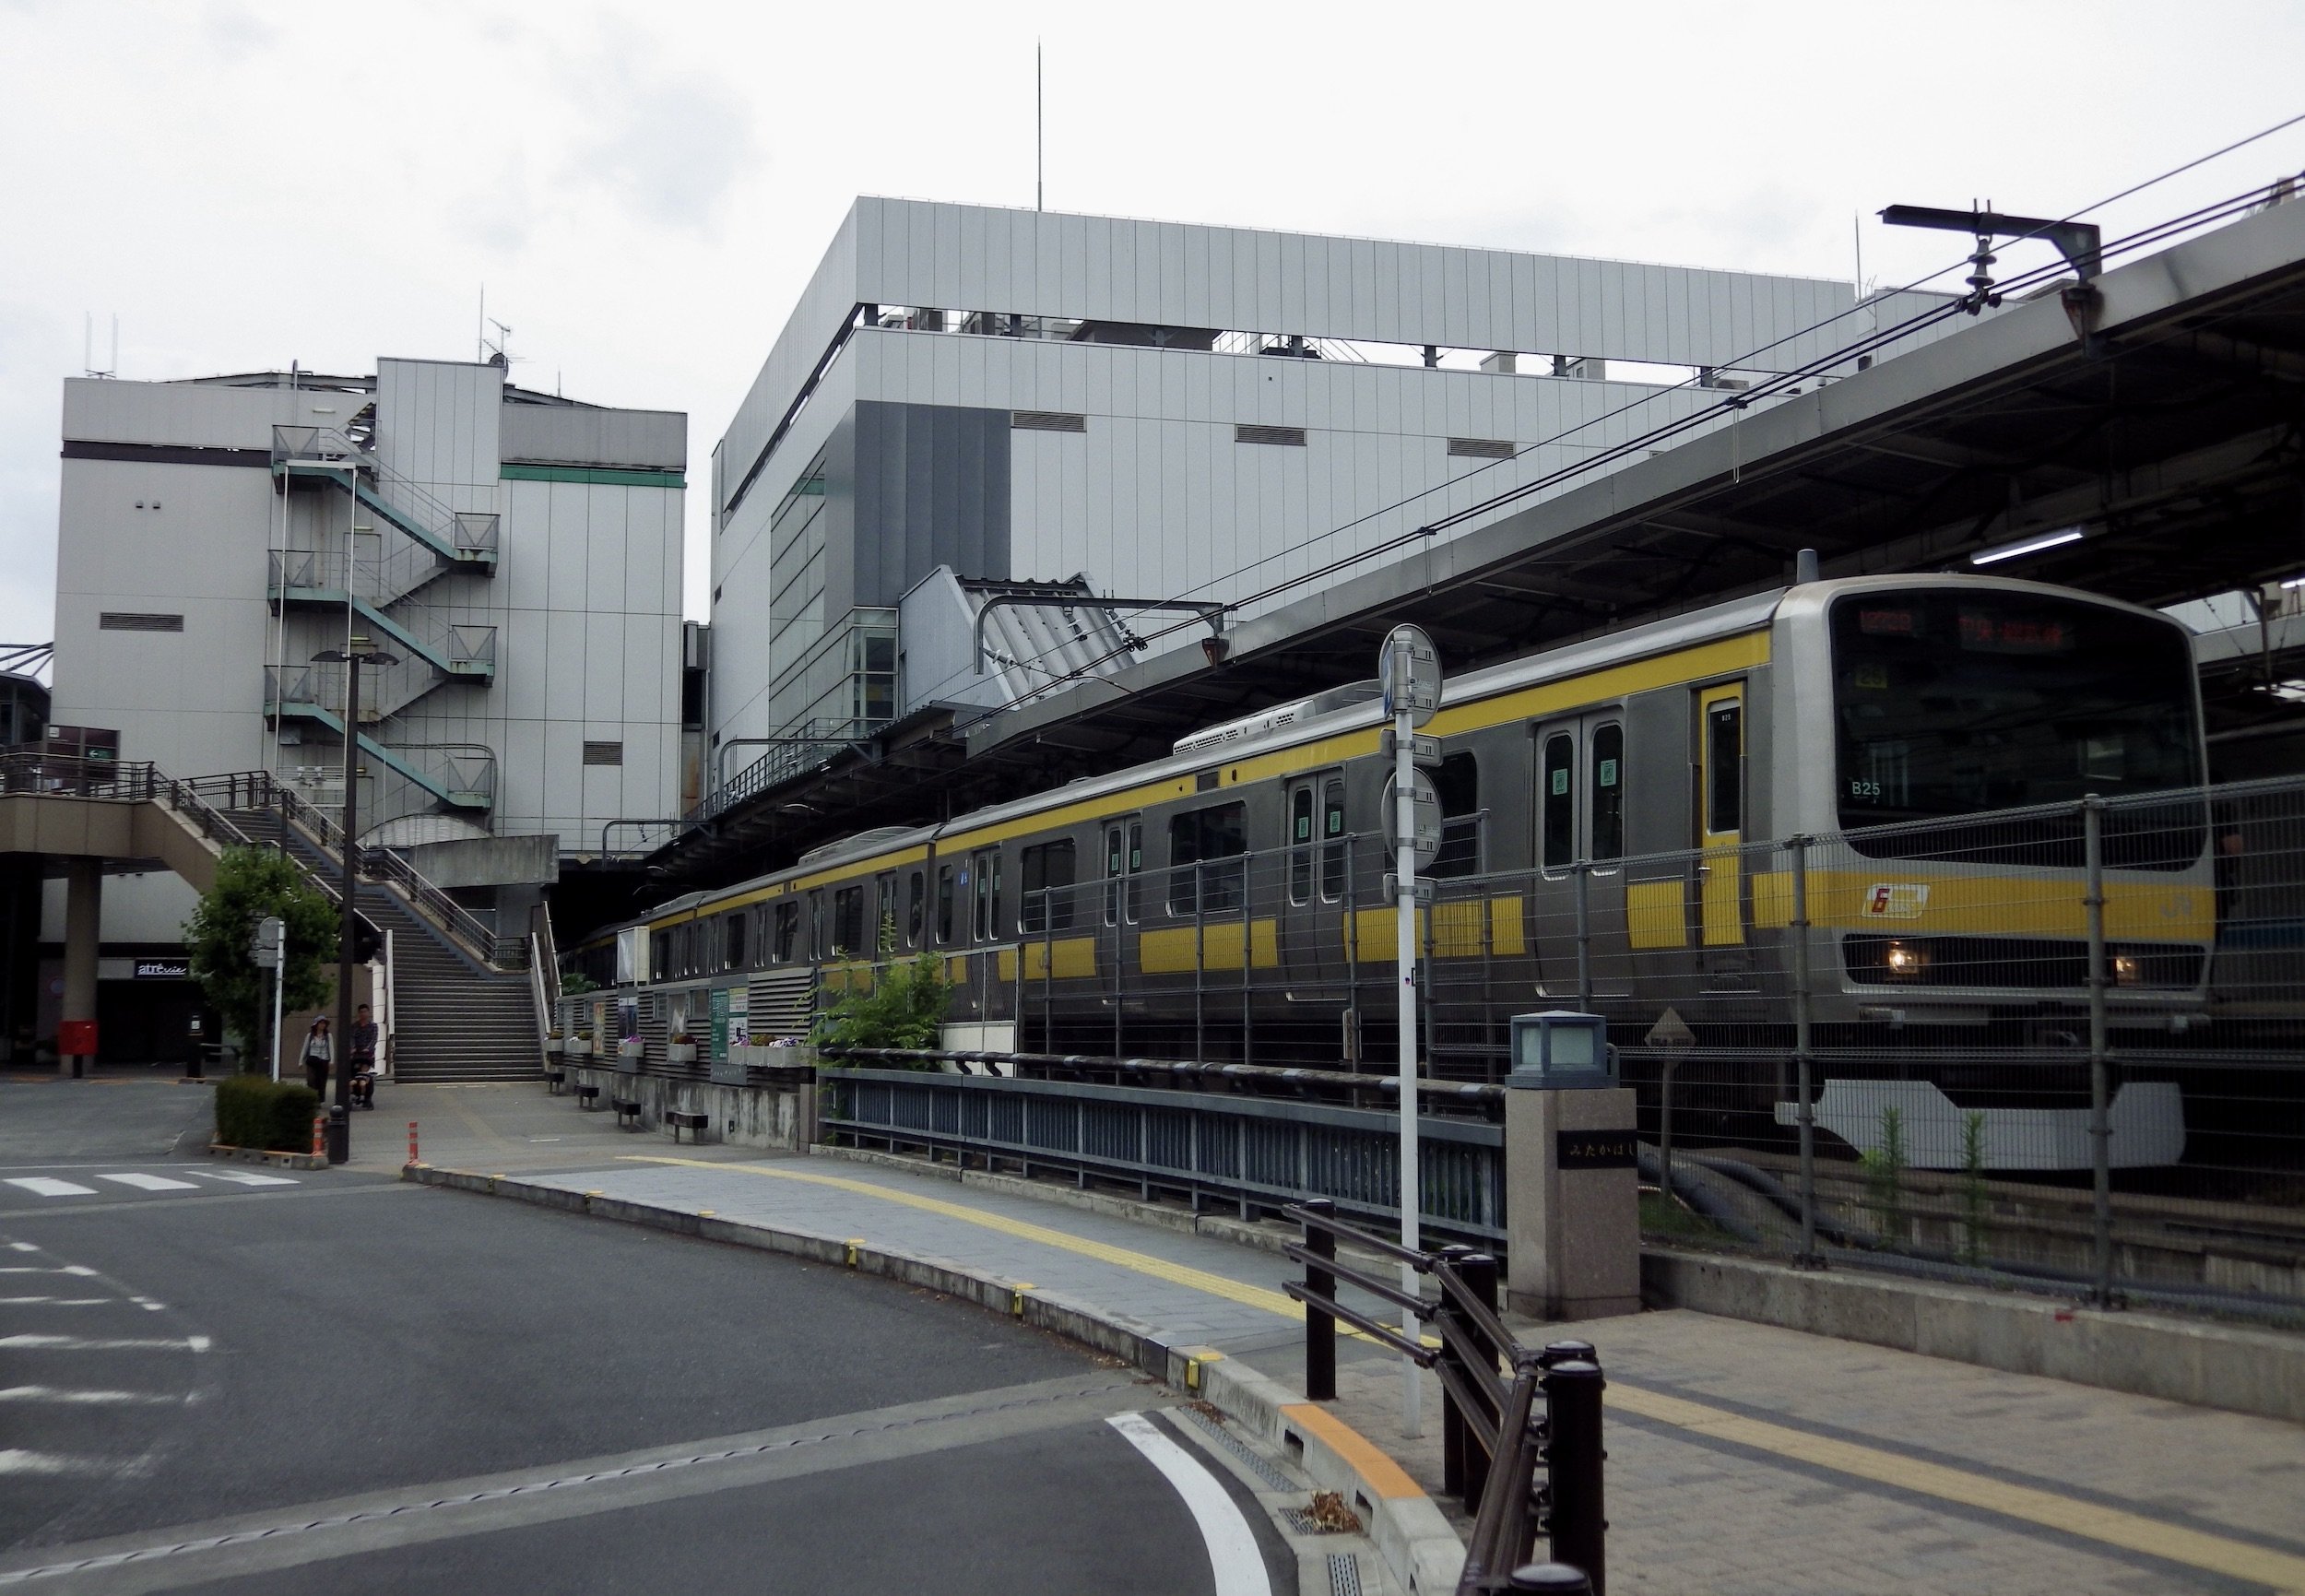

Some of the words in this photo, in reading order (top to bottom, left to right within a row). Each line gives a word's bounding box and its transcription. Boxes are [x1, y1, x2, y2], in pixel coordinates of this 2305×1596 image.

[1851, 781, 1881, 796] B25
[1569, 1142, 1635, 1157] みたかはし
